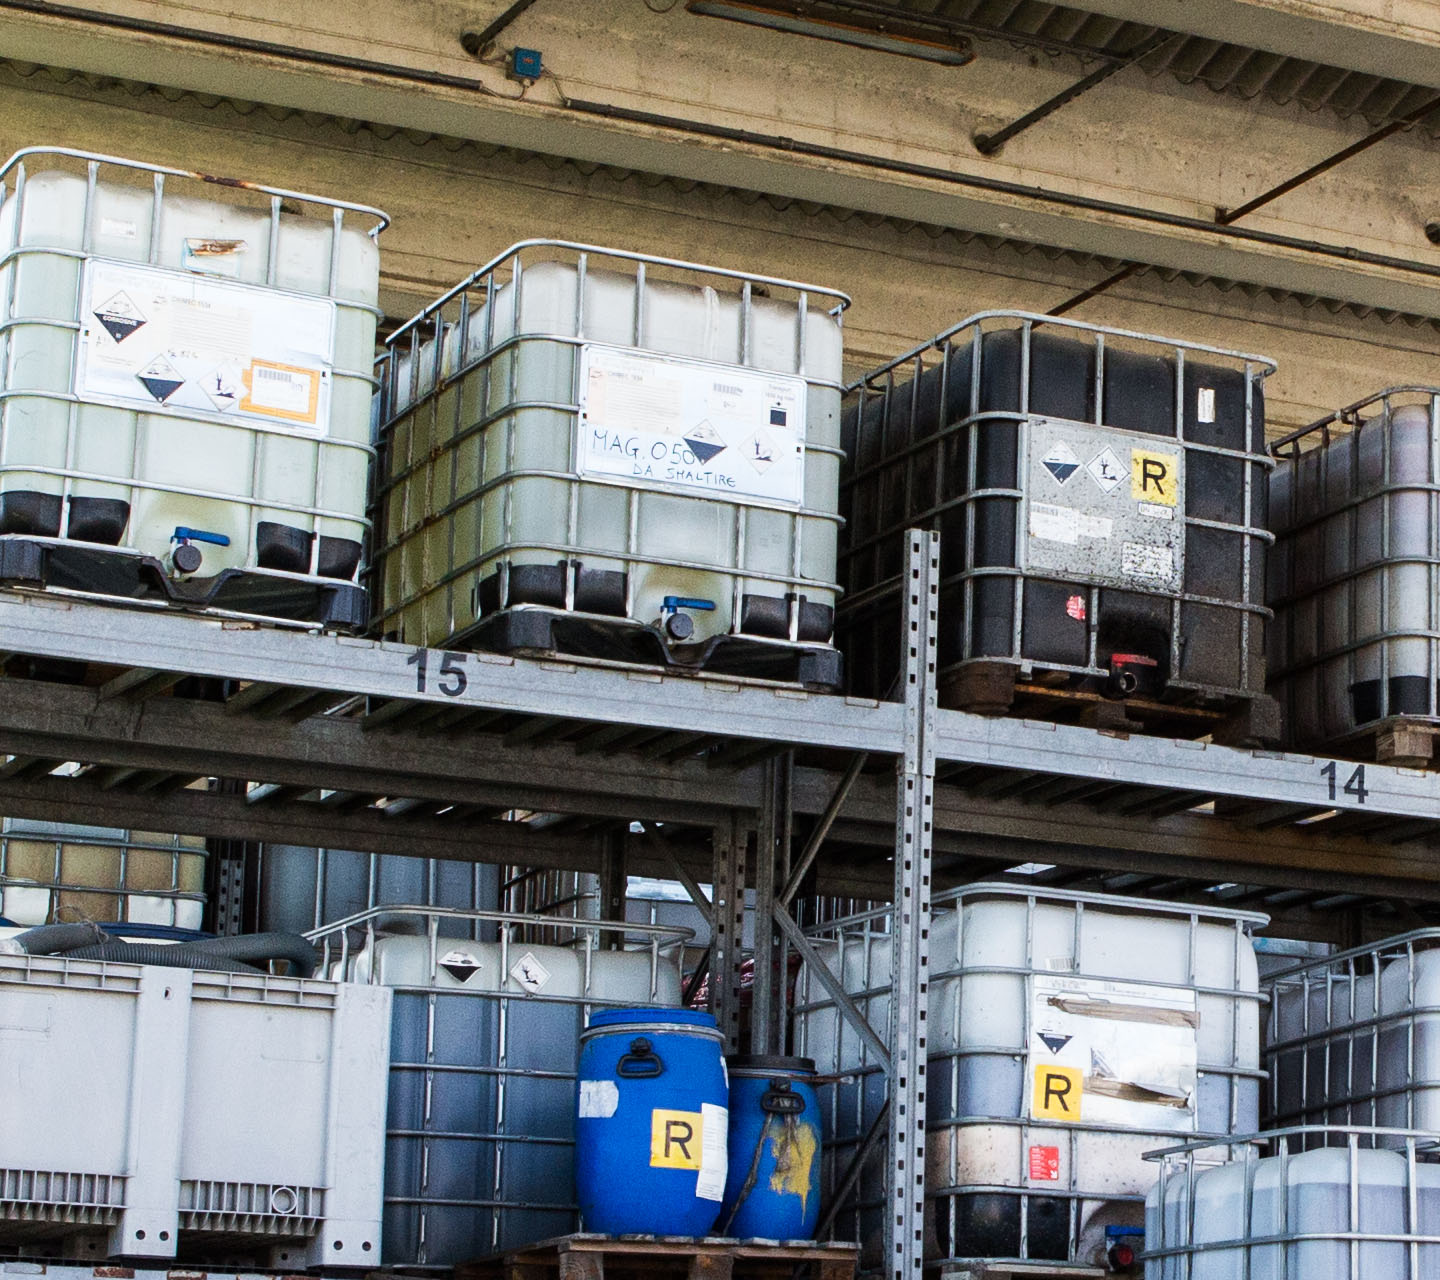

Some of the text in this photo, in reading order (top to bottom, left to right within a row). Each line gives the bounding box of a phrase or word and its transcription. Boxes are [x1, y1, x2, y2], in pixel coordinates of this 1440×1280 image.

[633, 463, 654, 477] DA
[1142, 458, 1167, 495] R
[406, 648, 468, 698] 15
[1320, 761, 1369, 804] 14
[1044, 1073, 1072, 1112] R
[664, 1120, 693, 1160] R
